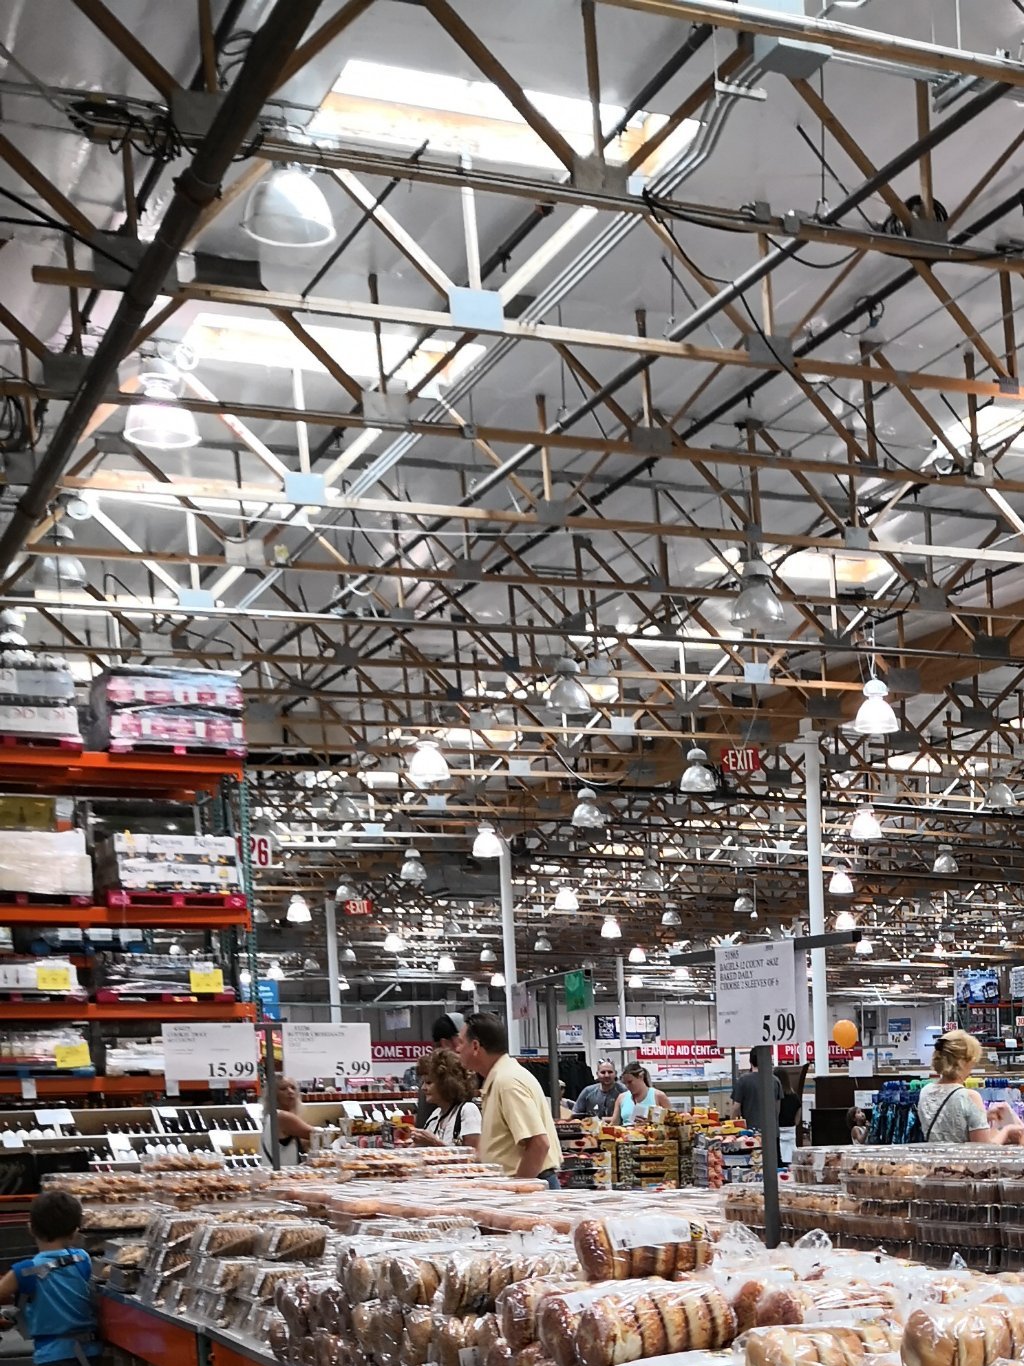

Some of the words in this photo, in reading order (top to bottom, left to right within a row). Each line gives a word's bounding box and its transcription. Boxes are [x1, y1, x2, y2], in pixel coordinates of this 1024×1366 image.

[728, 750, 754, 770] EXIT
[351, 900, 368, 914] EXIT
[720, 962, 739, 971] BAGELS
[745, 959, 764, 969] COUNT
[720, 972, 737, 981] BAKED
[738, 970, 753, 980] DAILY
[720, 980, 740, 991] CHOOSE
[745, 979, 767, 989] SLEEVES
[762, 1013, 796, 1042] 5.99
[371, 1045, 434, 1058] OMETRIS
[641, 1045, 675, 1056] HEARING
[676, 1045, 690, 1056] AID
[691, 1045, 720, 1056] CENTER
[785, 1045, 813, 1055] PHOO
[208, 1062, 255, 1077] 15.99
[335, 1061, 371, 1076] 5.99
